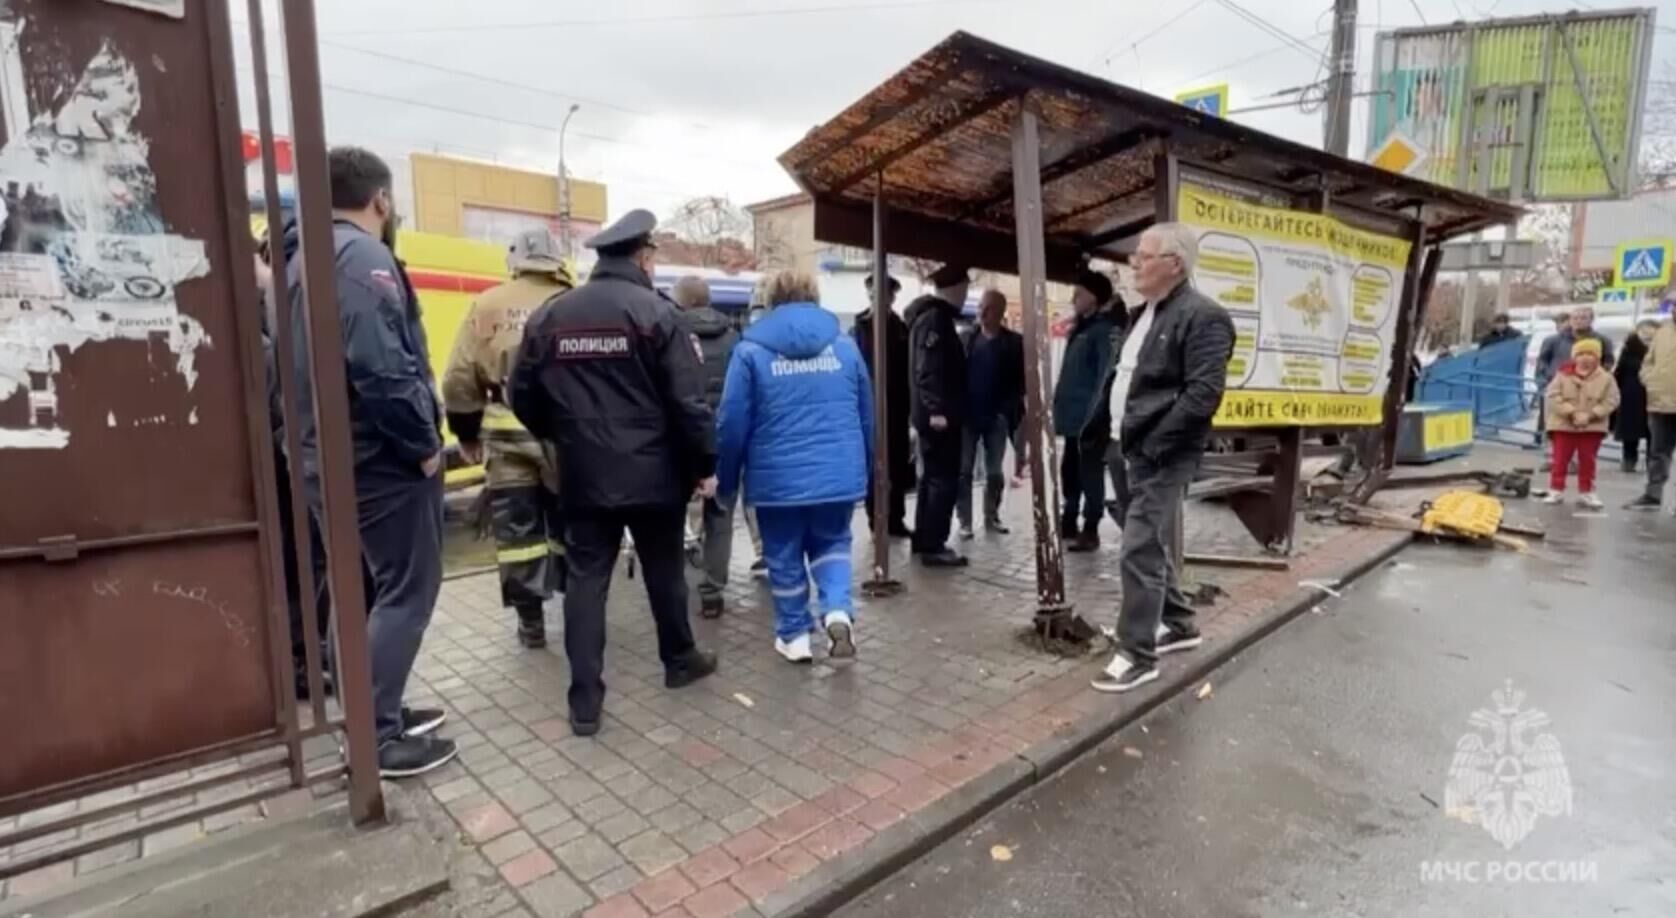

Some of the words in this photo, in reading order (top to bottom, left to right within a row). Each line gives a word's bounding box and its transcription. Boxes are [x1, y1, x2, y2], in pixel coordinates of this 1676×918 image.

[1194, 199, 1323, 238] ОСТЕРЕГАЙТЕСЬ
[560, 336, 629, 355] ПОЛИЦИЯ
[770, 356, 842, 377] ПОМОЩЬ
[1225, 398, 1274, 419] ДАЙТЕ
